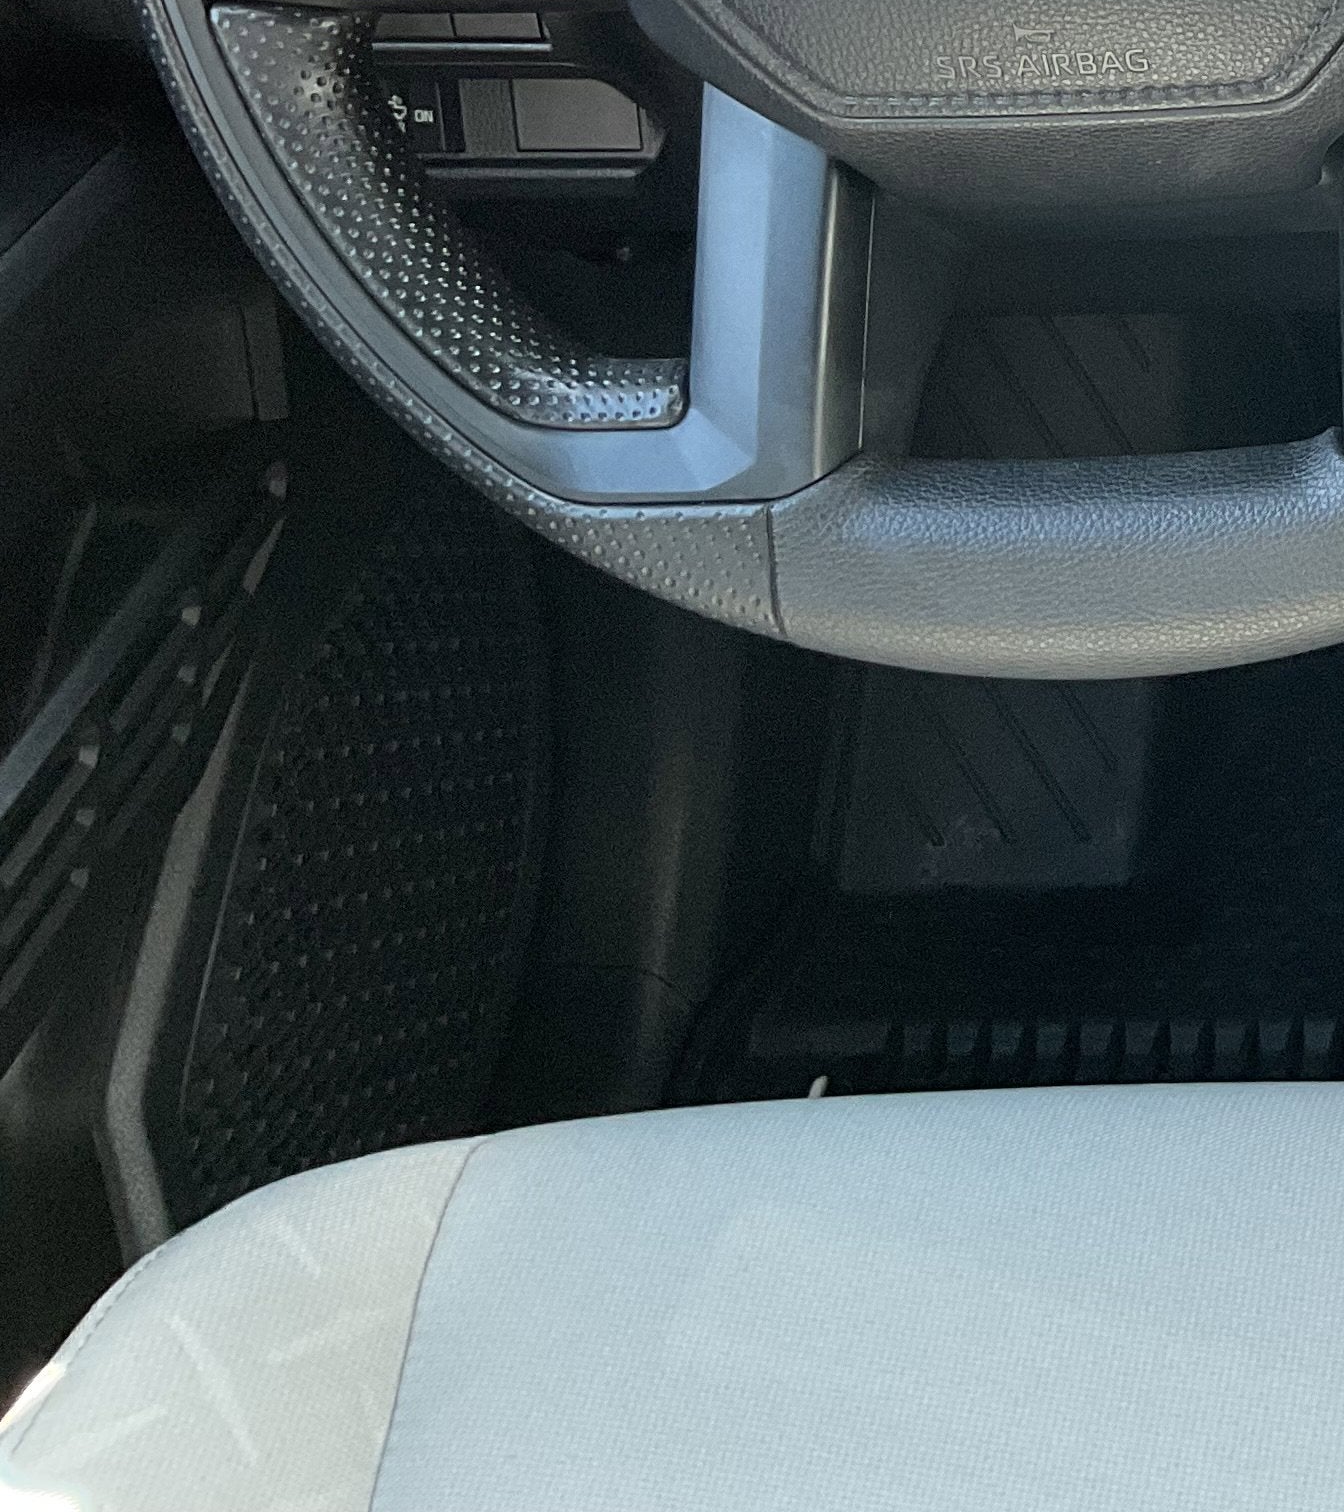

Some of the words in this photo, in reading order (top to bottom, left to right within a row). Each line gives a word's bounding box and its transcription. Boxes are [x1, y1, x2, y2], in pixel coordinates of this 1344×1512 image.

[936, 55, 1003, 80] SRS
[1016, 49, 1150, 77] AIRBAG
[414, 109, 434, 123] ON
